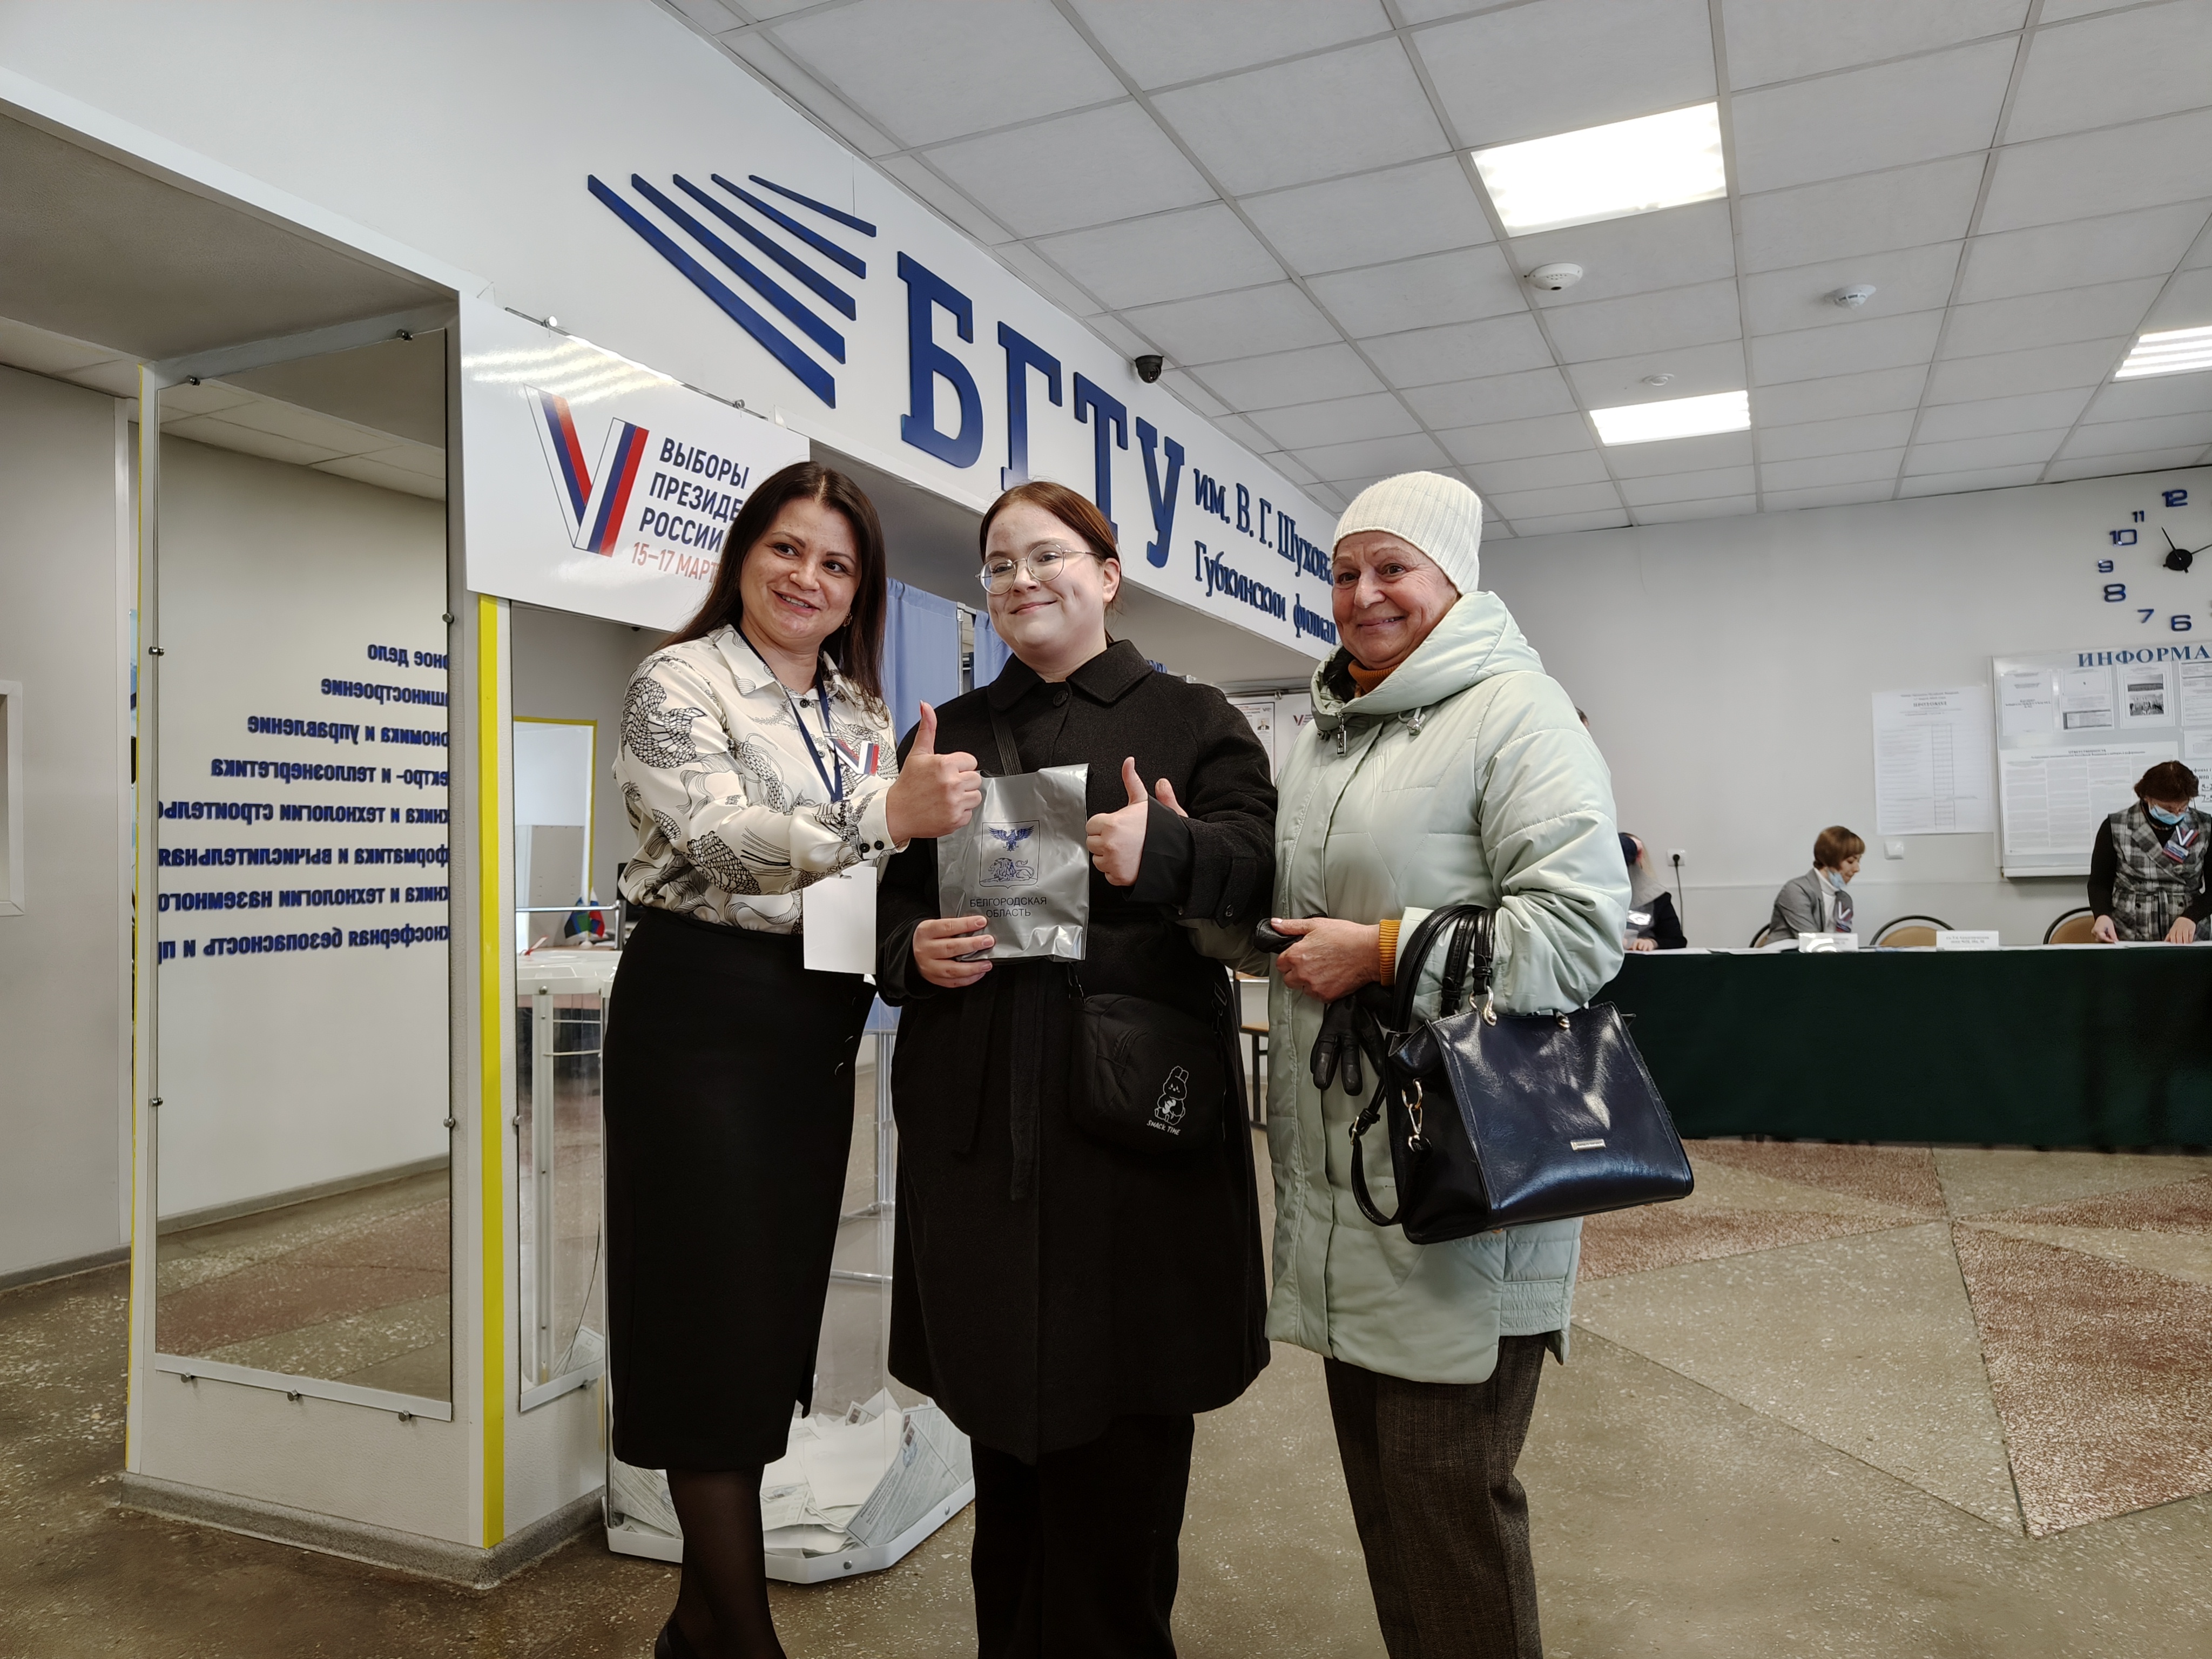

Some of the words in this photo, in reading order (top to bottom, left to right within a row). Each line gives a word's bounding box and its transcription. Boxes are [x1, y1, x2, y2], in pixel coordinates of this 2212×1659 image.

[898, 251, 1184, 568] БГТУ
[659, 437, 750, 489] ВЫБОРЫ
[649, 471, 743, 523] ПРЕЗИДЕ
[2162, 489, 2188, 508] 12
[1193, 468, 1230, 524] им.
[1236, 483, 1254, 537] В.
[1259, 498, 1272, 548] Г.
[2132, 510, 2145, 523] 11
[639, 507, 724, 553] РОССИИ
[2109, 529, 2137, 546] 10
[2098, 559, 2114, 573] 9
[2104, 583, 2126, 602] 8
[1293, 593, 1337, 645] филиал
[2137, 609, 2154, 623] 7
[2171, 615, 2192, 631] 6
[2078, 645, 2211, 667] ИНФОРМА
[970, 897, 1047, 907] БЕЛГОРОДСКАЯ
[986, 908, 1031, 918] ОБЛАСТЬ
[1147, 1120, 1166, 1131] SNACK
[1167, 1125, 1181, 1136] TIME
